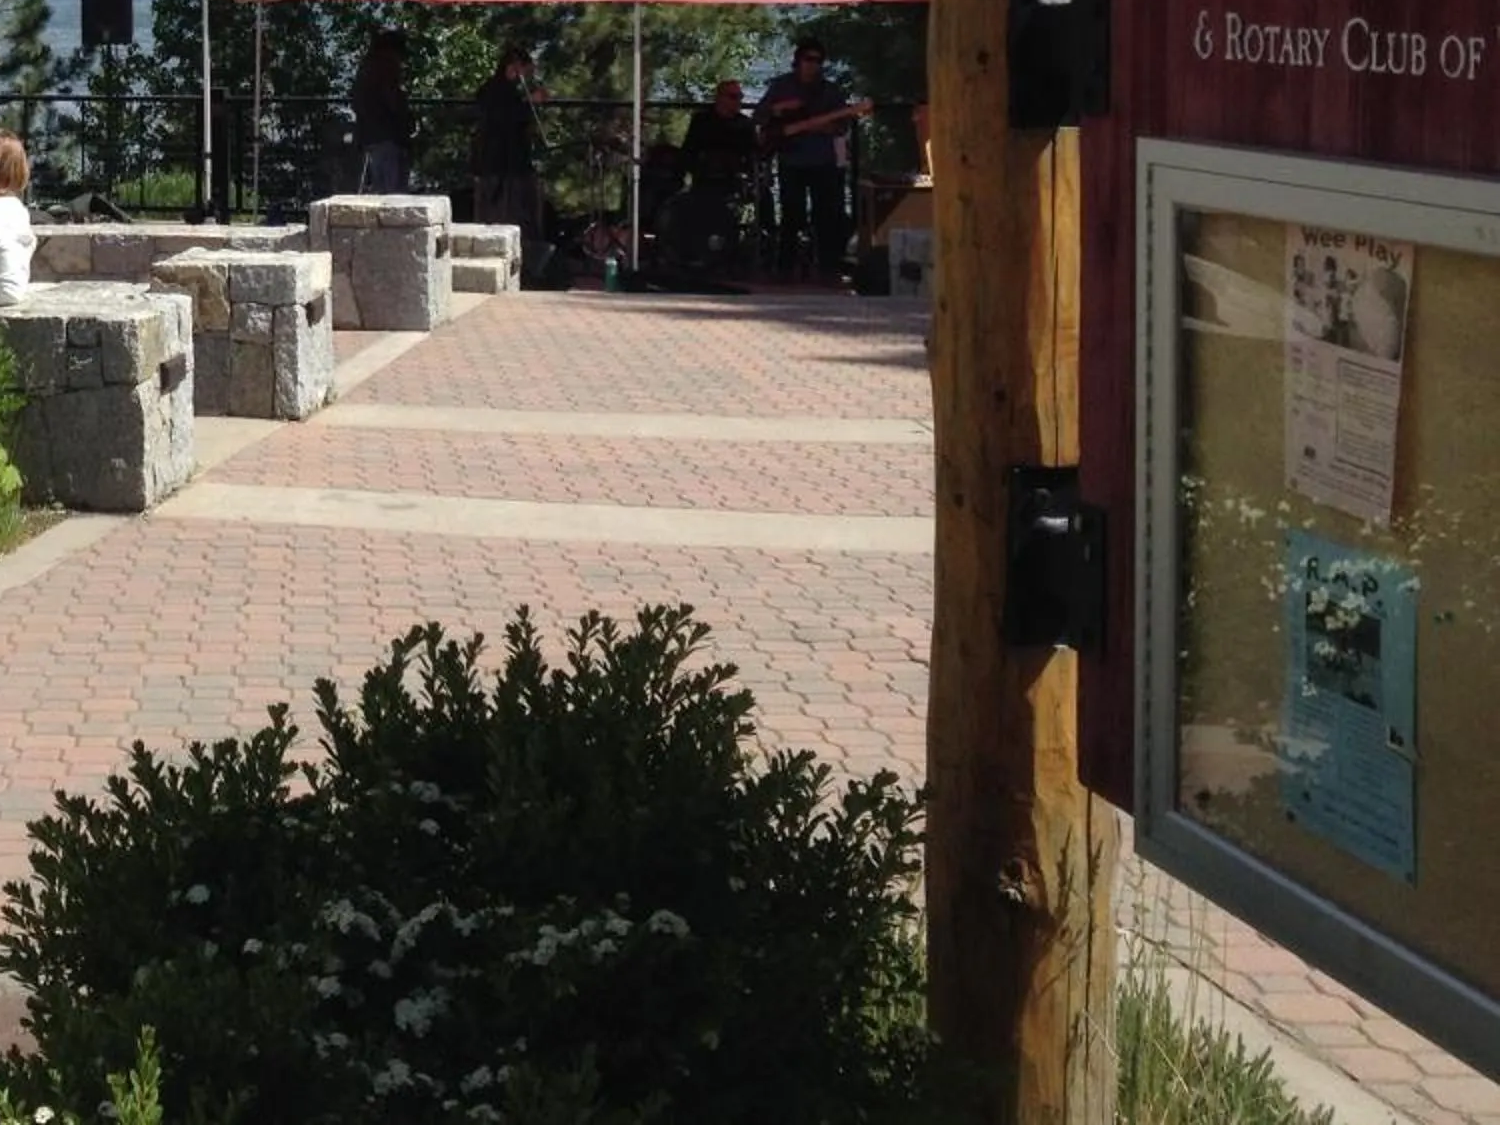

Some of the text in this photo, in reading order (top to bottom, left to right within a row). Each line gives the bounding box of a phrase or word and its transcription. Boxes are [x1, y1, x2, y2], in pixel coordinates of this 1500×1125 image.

[1225, 11, 1331, 68] ROTARY
[1341, 17, 1427, 76] CLUB
[1439, 34, 1486, 81] OF
